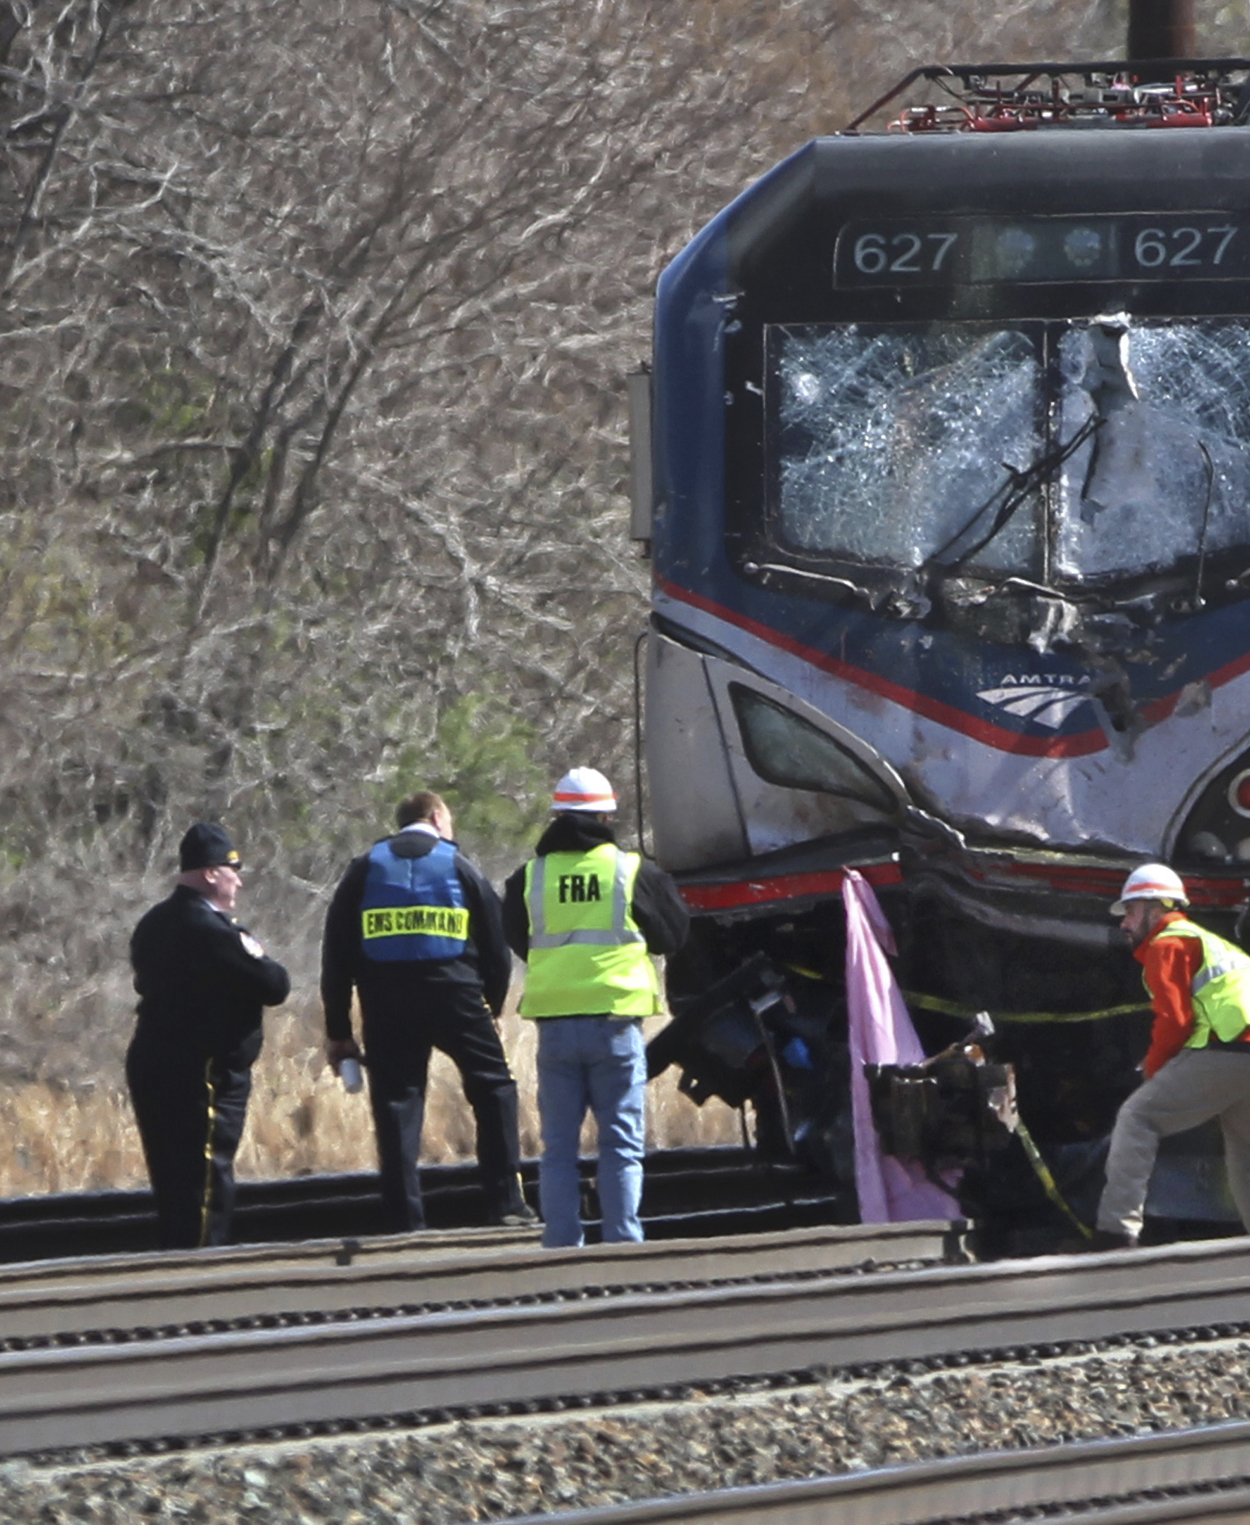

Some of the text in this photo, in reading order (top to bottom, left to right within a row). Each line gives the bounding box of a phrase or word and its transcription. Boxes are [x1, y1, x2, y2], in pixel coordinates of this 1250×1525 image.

[853, 232, 958, 274] 627
[1133, 226, 1239, 268] 627
[1001, 673, 1091, 685] AMTRA
[558, 873, 601, 904] FRA
[367, 909, 463, 935] EMS COMMAND
